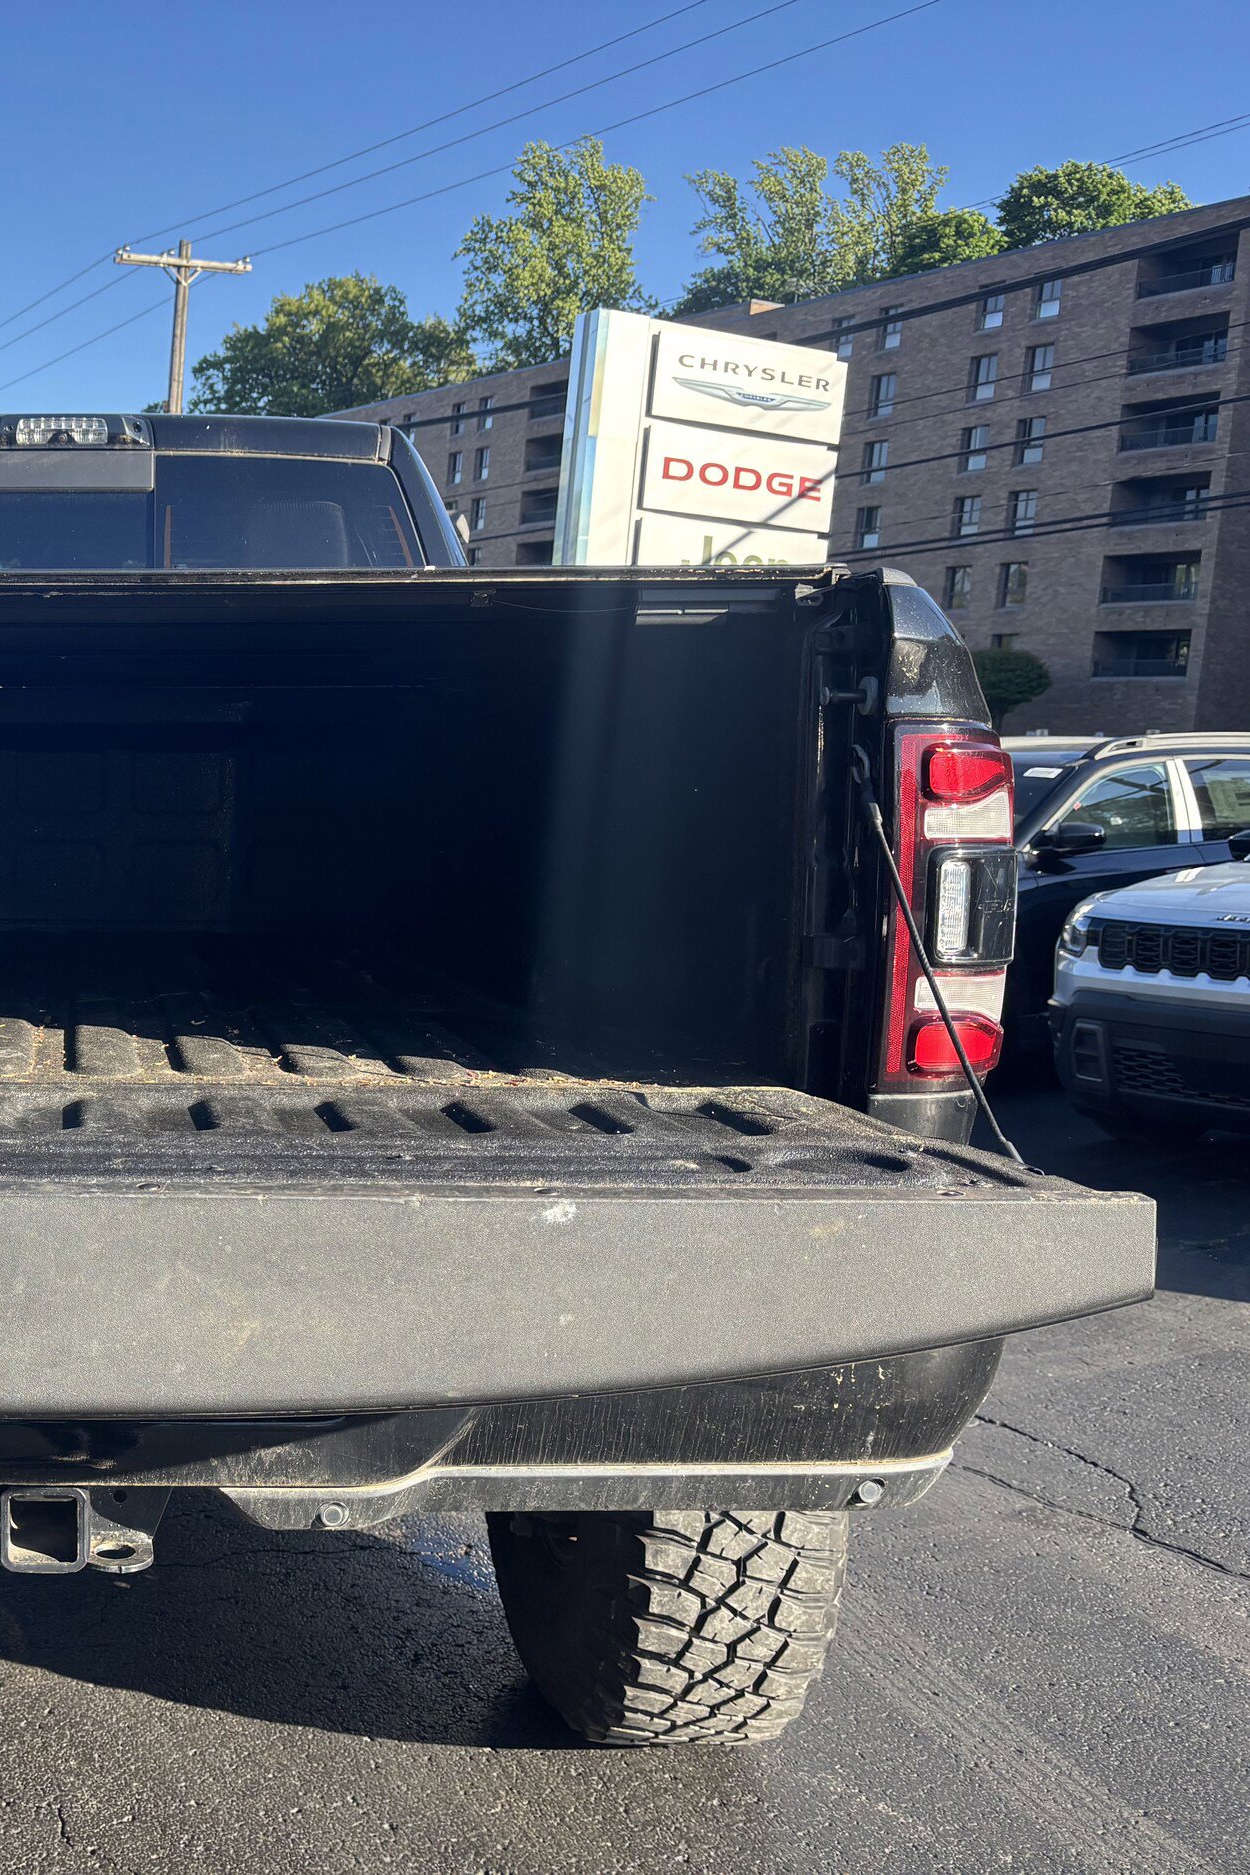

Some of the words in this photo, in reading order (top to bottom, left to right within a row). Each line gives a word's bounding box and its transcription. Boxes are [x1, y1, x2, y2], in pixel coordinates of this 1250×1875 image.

[678, 354, 831, 392] CHRYSLER
[662, 456, 823, 502] DODGE
[680, 535, 789, 566] Je
